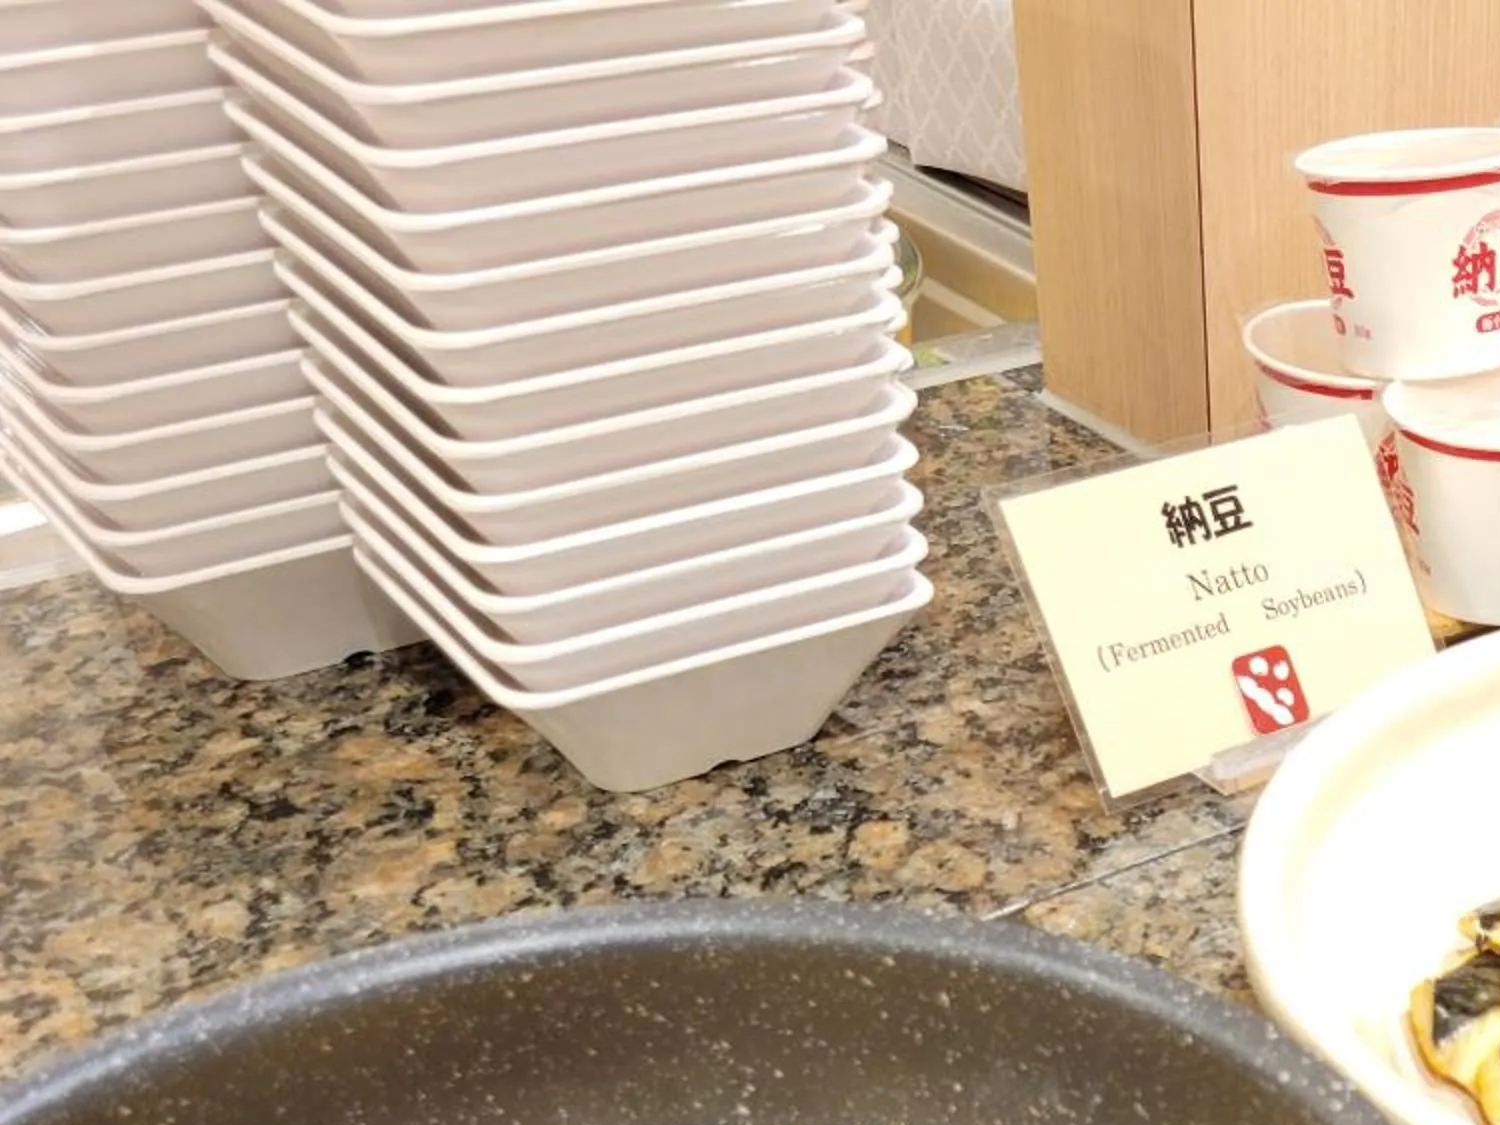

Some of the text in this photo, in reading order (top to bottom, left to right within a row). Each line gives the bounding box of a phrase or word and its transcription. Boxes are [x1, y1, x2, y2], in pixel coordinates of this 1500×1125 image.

[1161, 484, 1253, 549] 納豆
[1186, 560, 1270, 602] Natto
[1097, 568, 1368, 673] (Fermented Soybeans)
